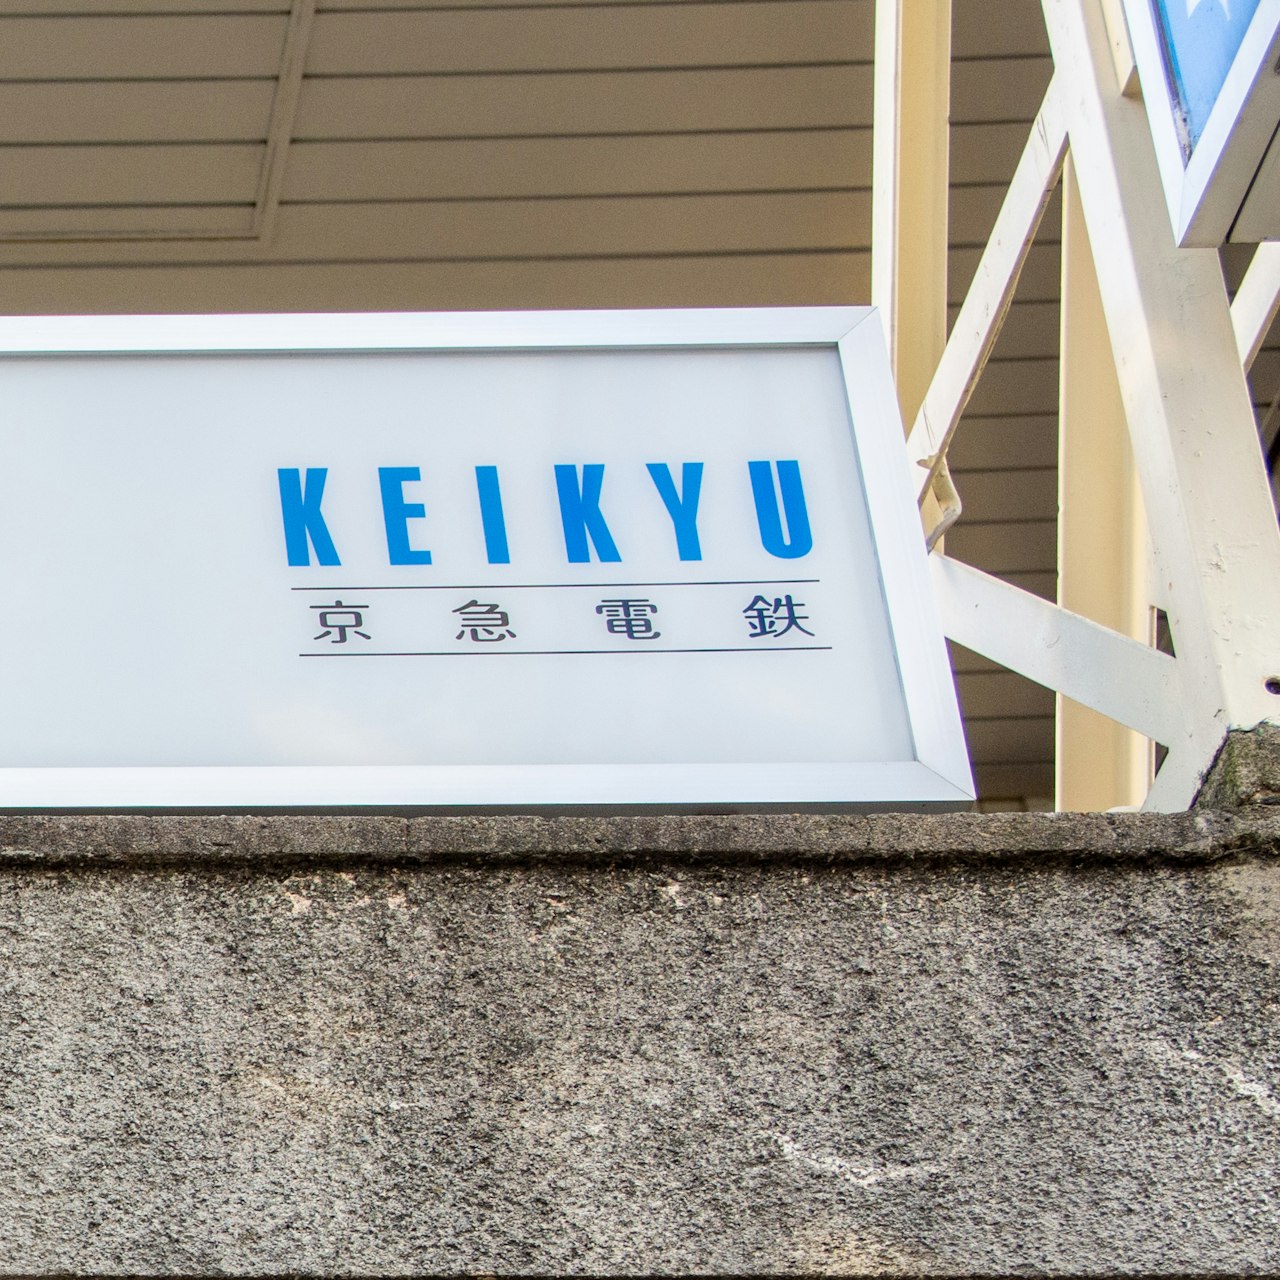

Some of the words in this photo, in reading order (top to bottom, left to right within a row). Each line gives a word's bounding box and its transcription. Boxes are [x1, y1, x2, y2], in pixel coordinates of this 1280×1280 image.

[276, 460, 814, 567] KEIKYU
[309, 594, 816, 644] 京急電鉄
